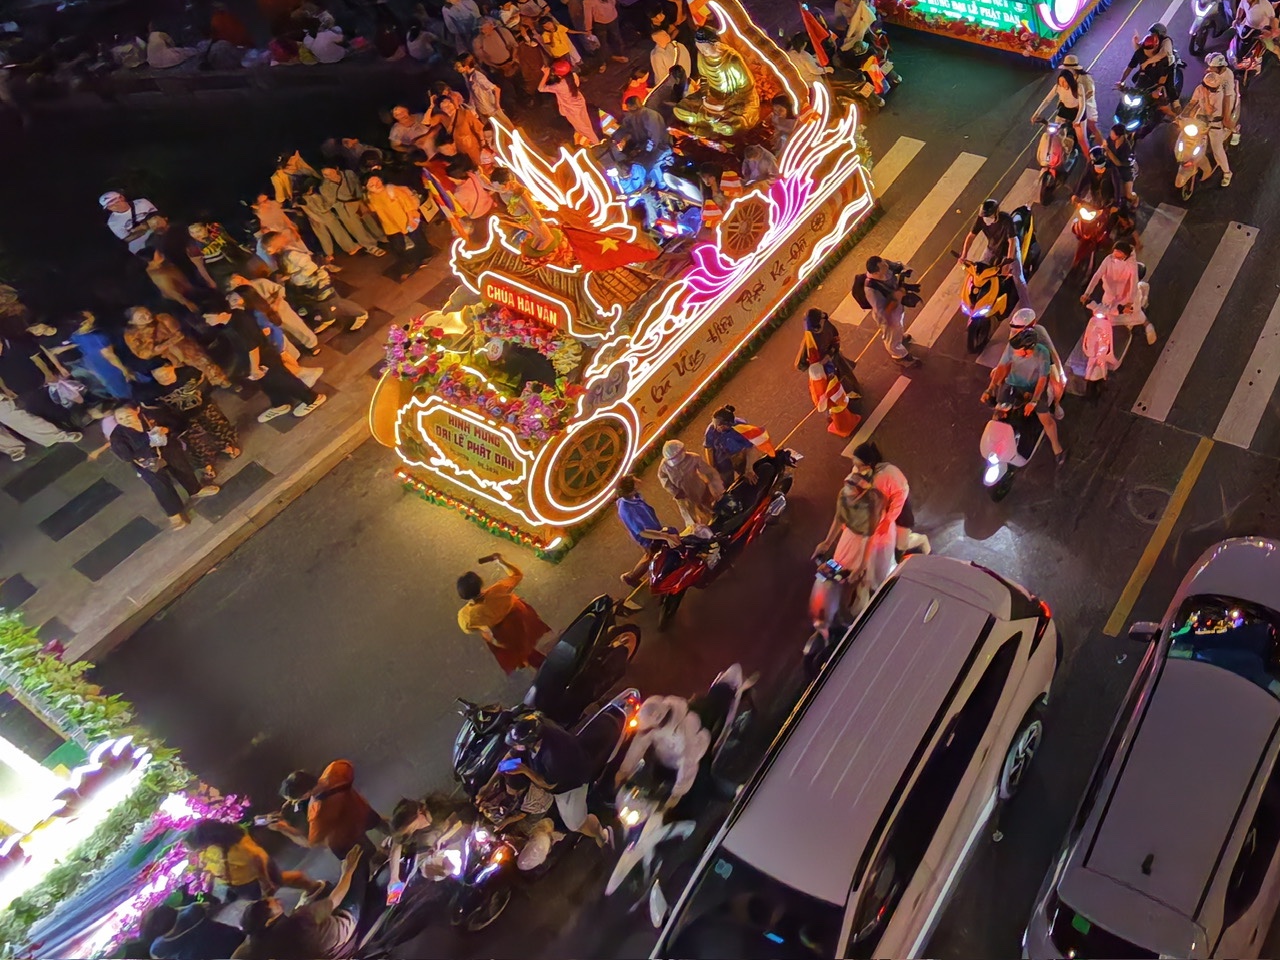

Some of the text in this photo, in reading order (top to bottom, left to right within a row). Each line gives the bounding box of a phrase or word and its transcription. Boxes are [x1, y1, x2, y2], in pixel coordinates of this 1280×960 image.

[517, 294, 535, 316] HẢI
[537, 304, 557, 326] VÂN
[467, 441, 492, 461] PHẬT
